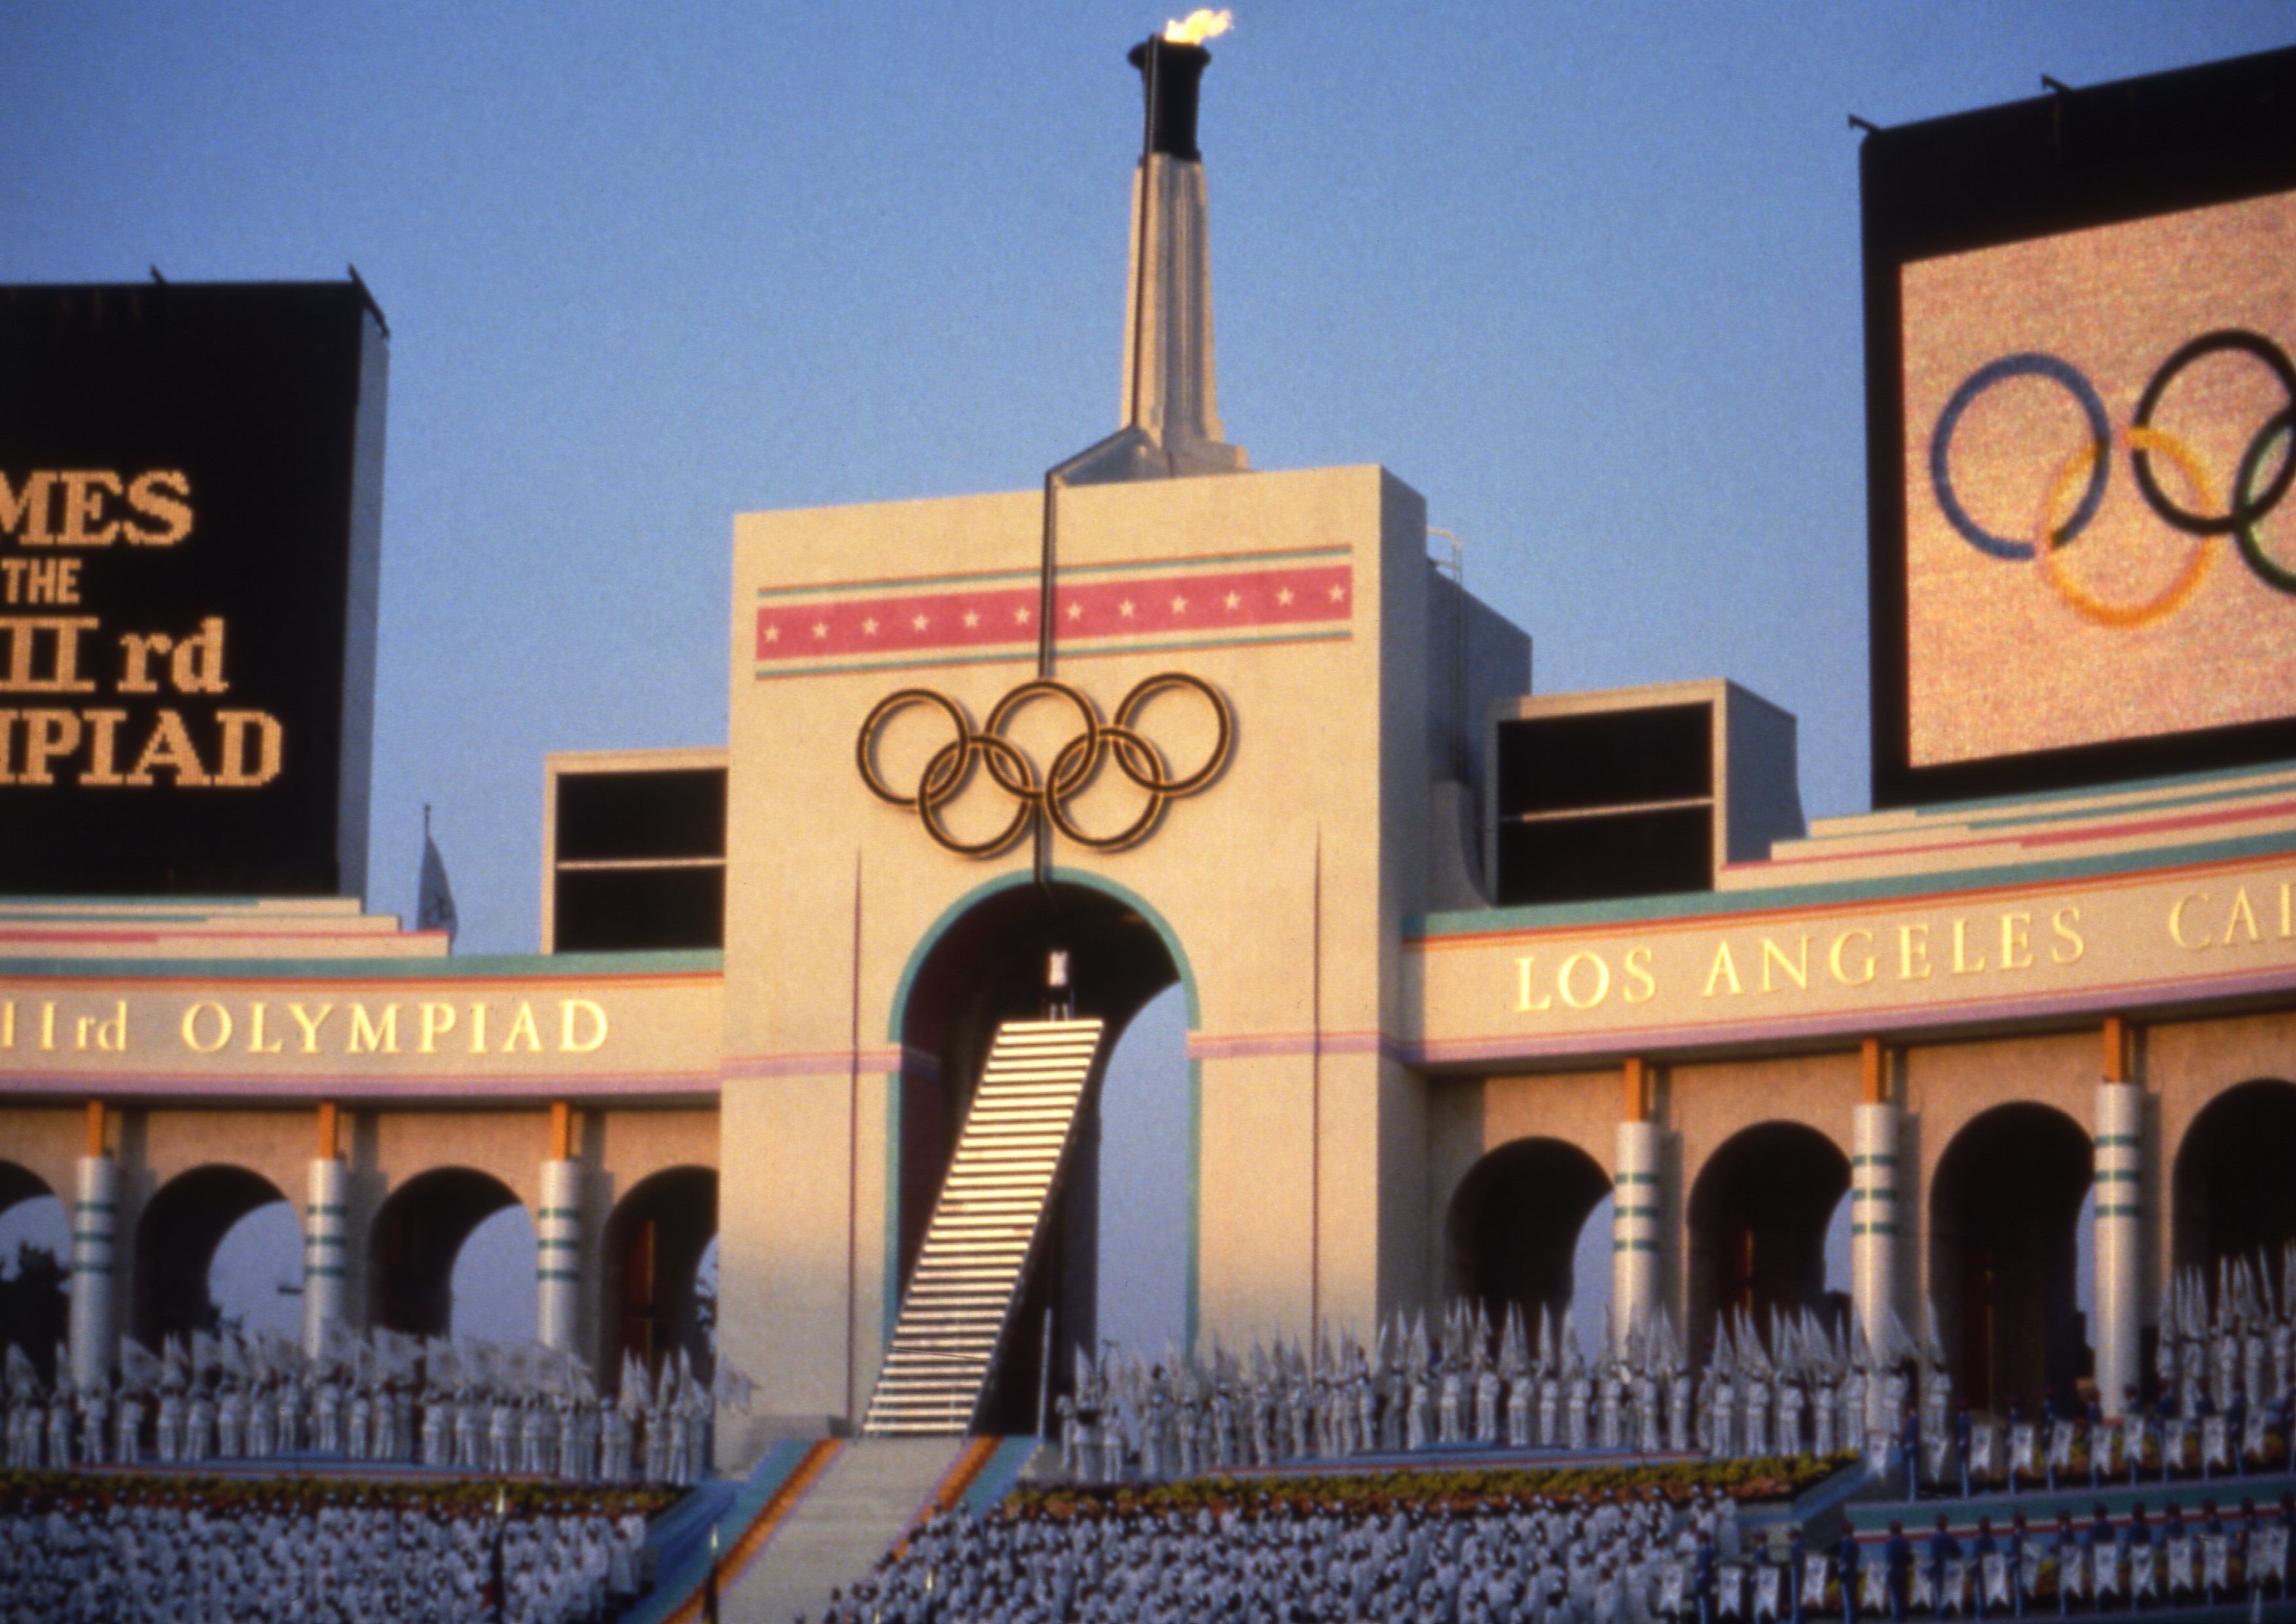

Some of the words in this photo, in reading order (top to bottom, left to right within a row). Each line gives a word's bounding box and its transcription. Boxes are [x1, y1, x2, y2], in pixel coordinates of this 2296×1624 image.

[1, 557, 82, 604] THE
[0, 709, 283, 787] PIAD
[1514, 946, 1656, 1012] LOS
[1702, 906, 2085, 997] ANGELES
[180, 998, 609, 1054] OLYMPIAD
